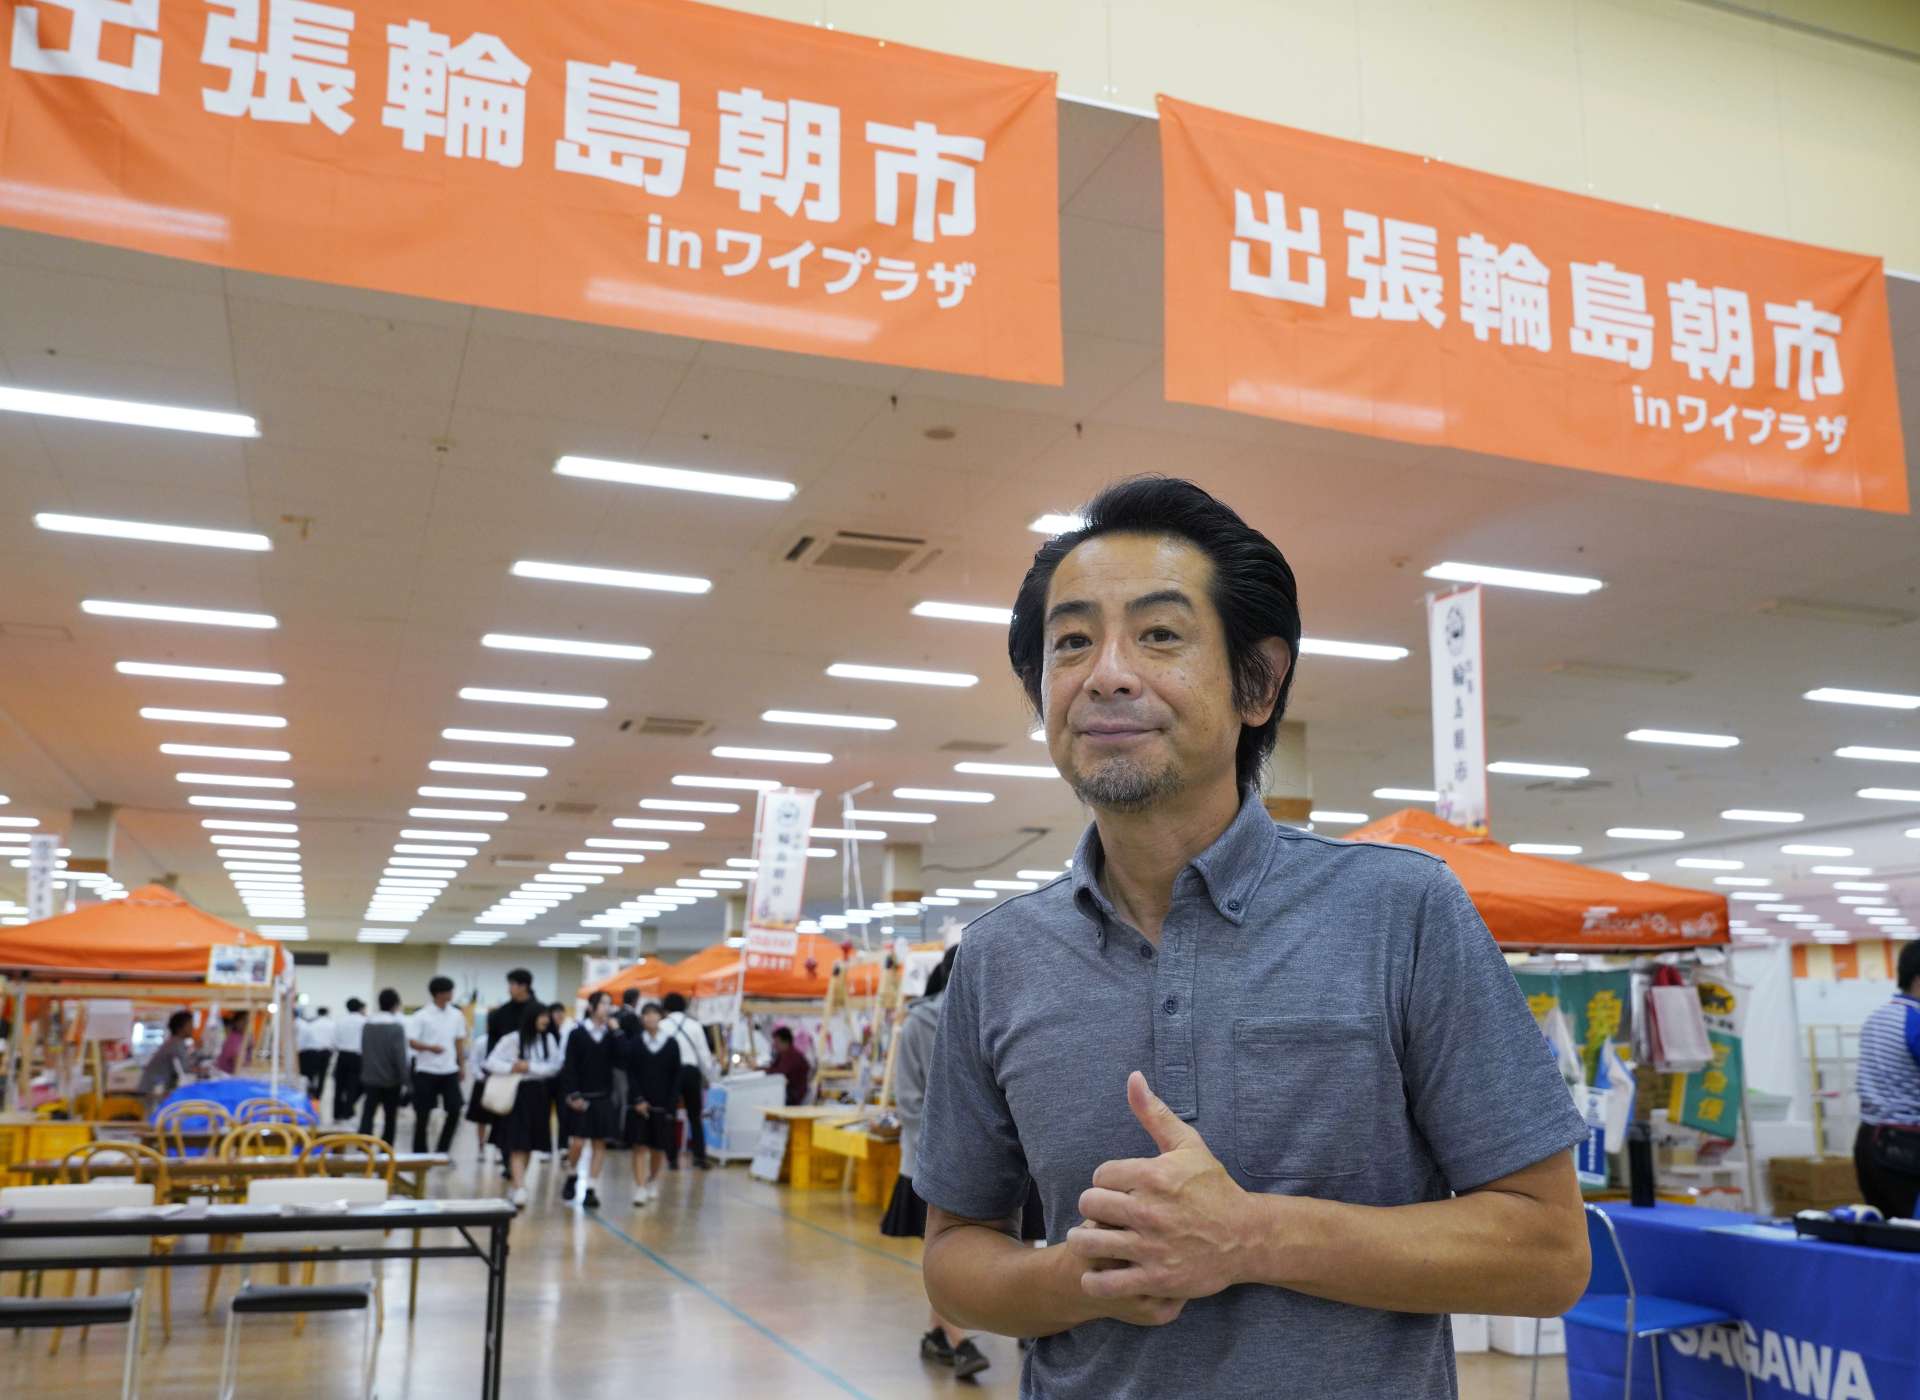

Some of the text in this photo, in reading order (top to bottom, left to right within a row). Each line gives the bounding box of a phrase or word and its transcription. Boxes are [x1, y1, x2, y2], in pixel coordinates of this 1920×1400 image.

[10, 0, 986, 243] 出張輪島朝市
[1228, 188, 1845, 400] 出張輪島朝市
